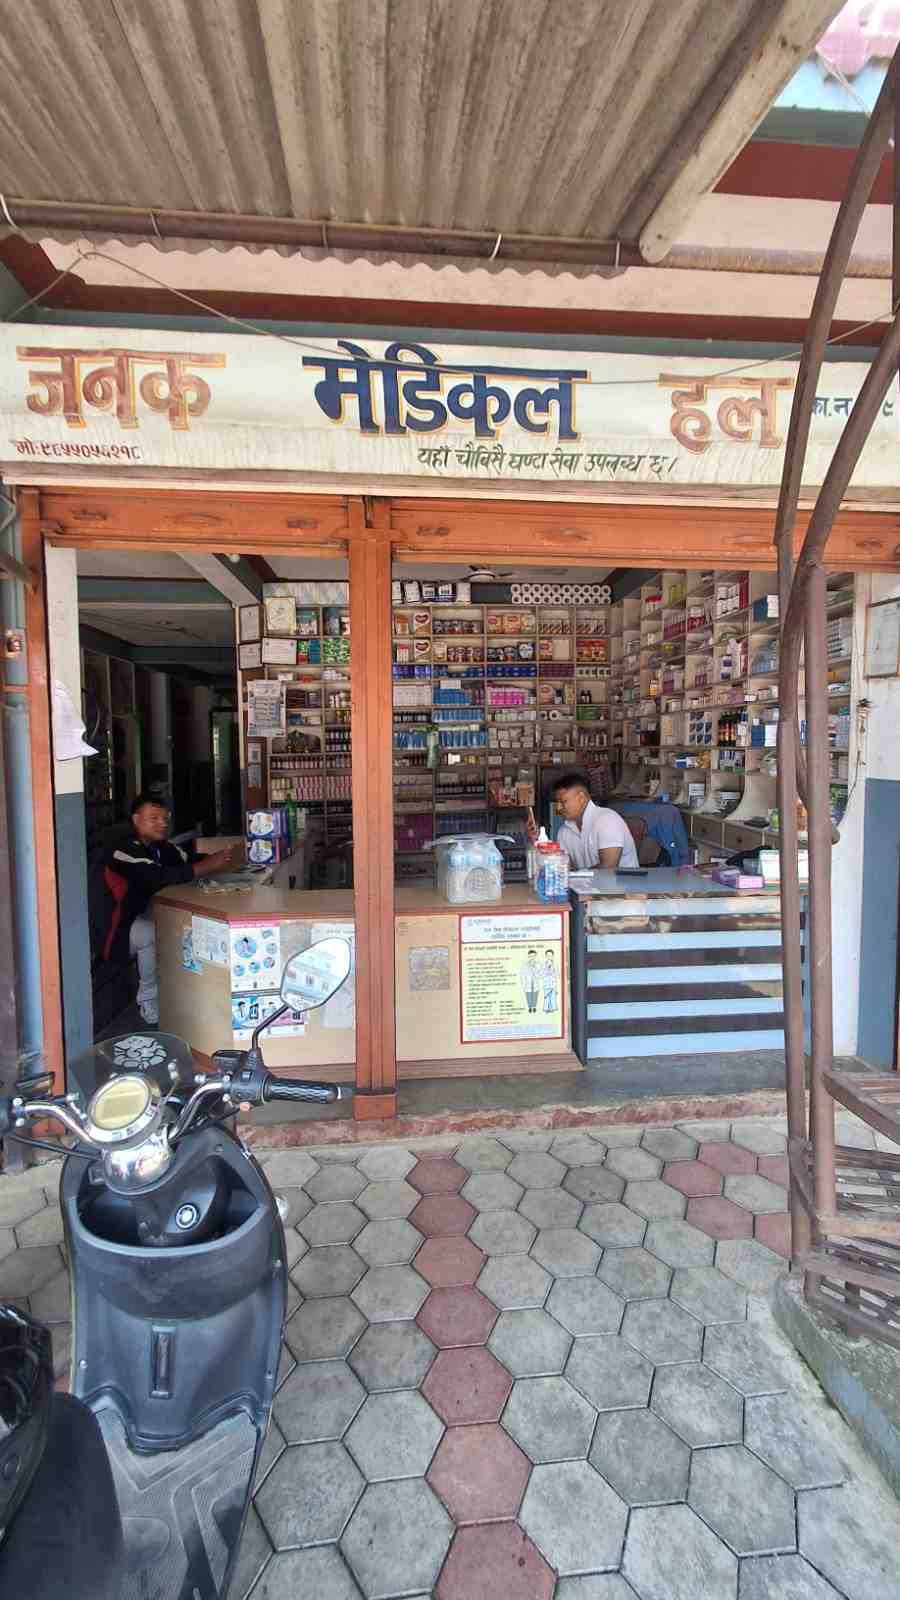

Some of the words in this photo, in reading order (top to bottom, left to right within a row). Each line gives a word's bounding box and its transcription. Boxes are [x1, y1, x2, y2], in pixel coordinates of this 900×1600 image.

[16, 345, 227, 431] जनक
[302, 339, 591, 442] मेडिकल
[656, 373, 793, 455] हल
[549, 447, 582, 477] सेवा
